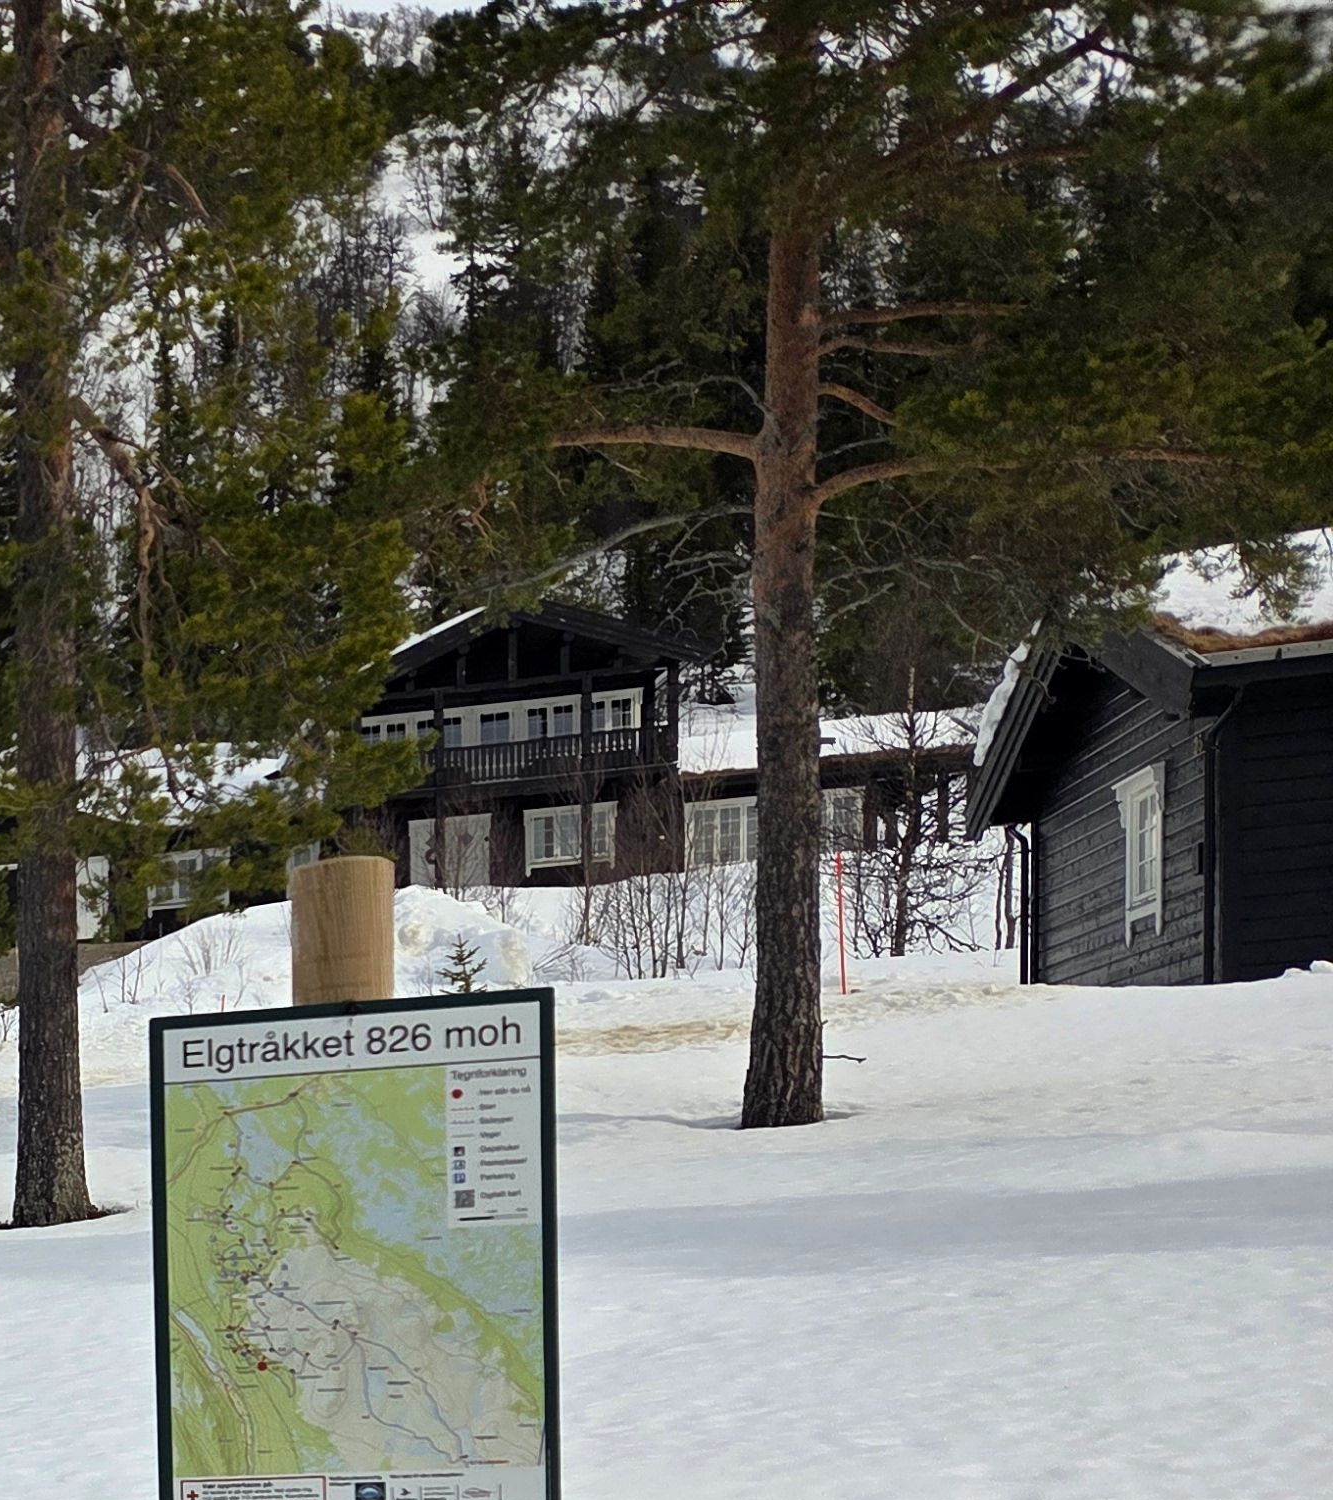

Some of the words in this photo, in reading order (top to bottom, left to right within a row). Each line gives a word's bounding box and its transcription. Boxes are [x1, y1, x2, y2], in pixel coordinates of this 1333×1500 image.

[183, 1029, 355, 1073] Elgtråkket
[366, 1024, 431, 1055] 826
[444, 1016, 521, 1049] moh
